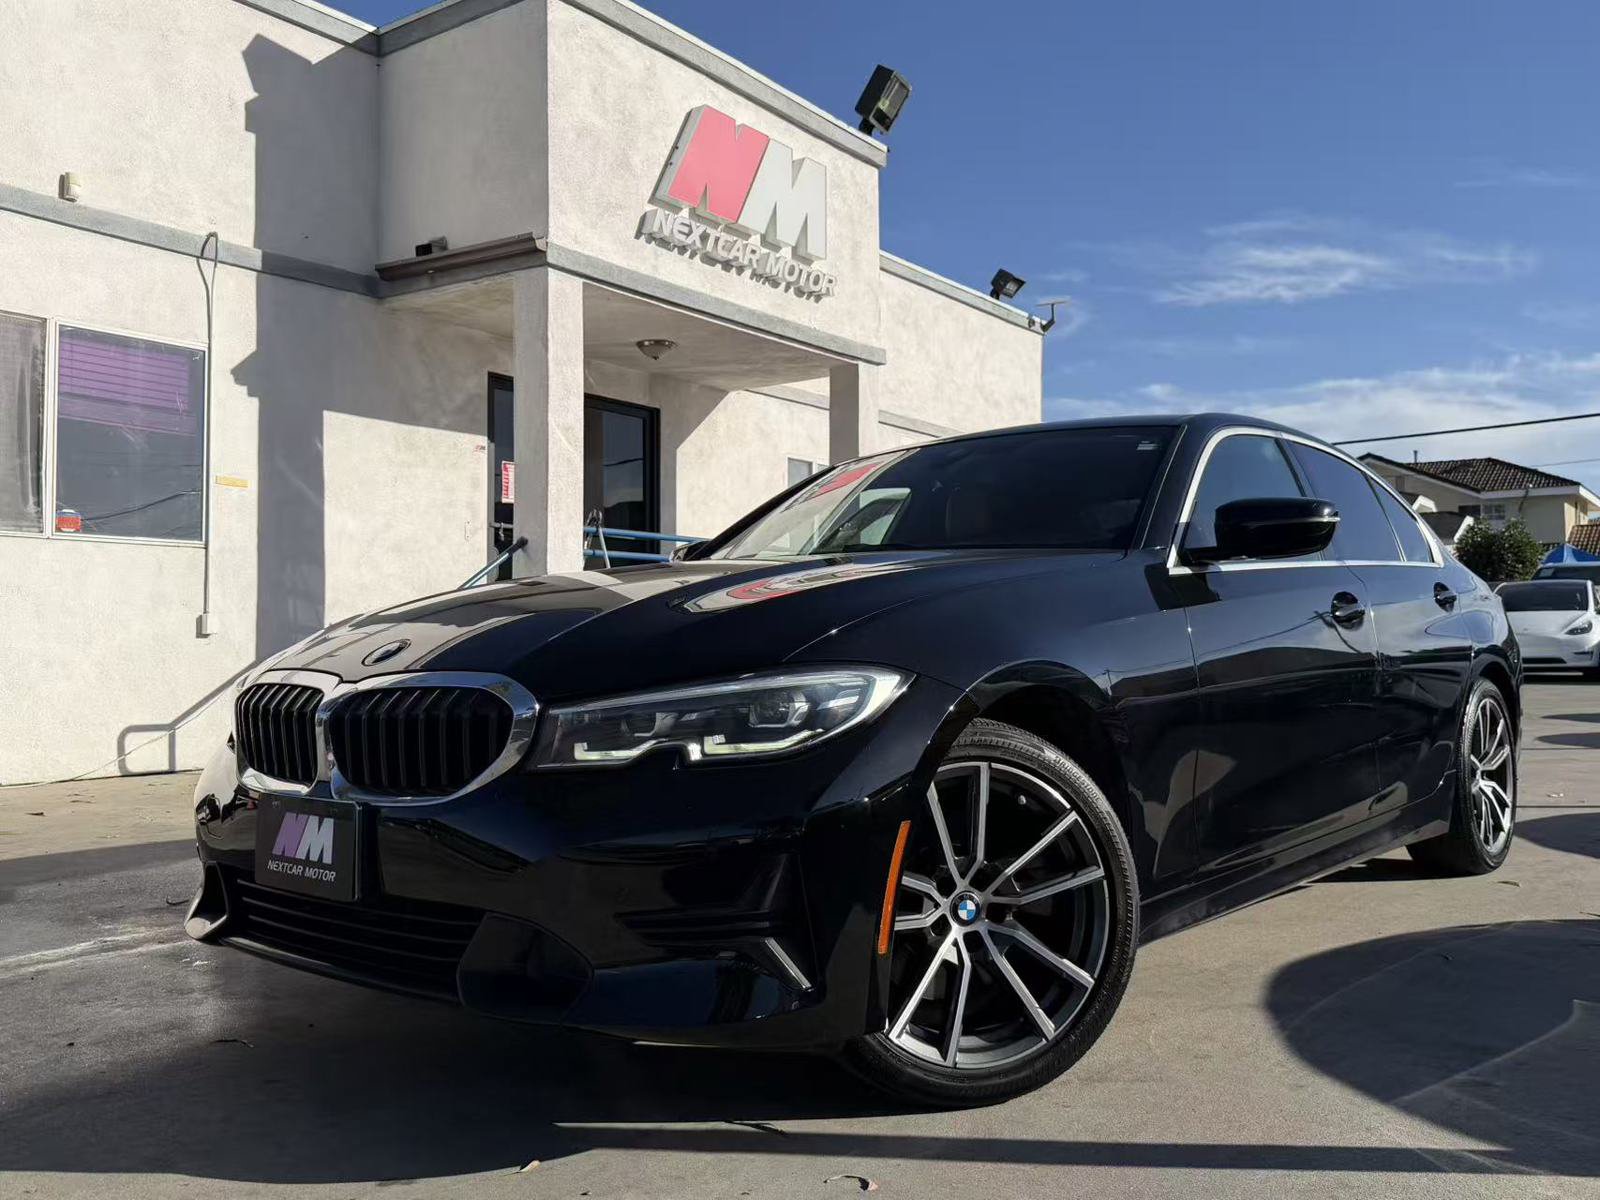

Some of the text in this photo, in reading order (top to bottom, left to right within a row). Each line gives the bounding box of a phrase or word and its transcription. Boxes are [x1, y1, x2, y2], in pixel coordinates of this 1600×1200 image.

[646, 207, 837, 297] NEXTCAR MOTOR
[267, 860, 336, 882] NEXTCAR MOTOR
